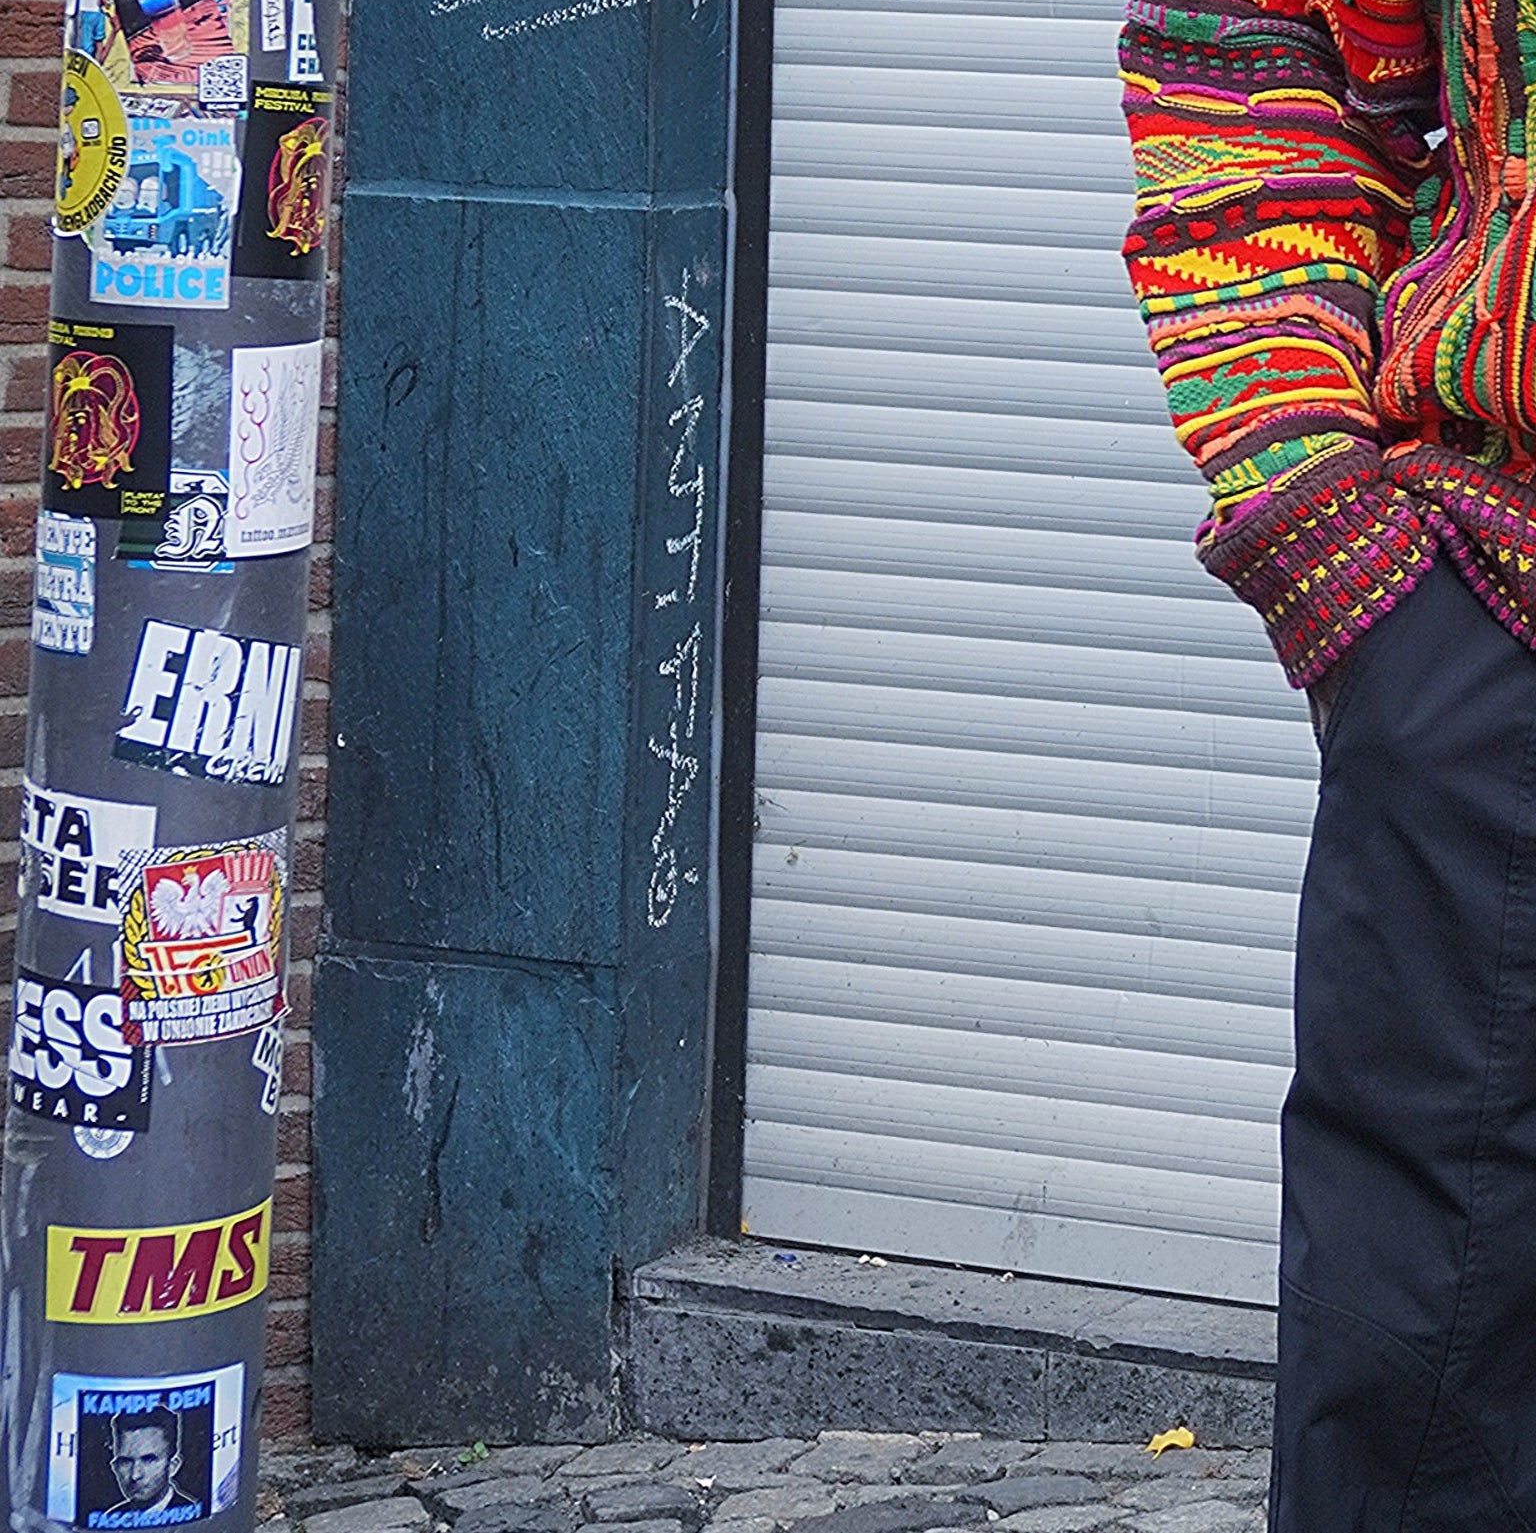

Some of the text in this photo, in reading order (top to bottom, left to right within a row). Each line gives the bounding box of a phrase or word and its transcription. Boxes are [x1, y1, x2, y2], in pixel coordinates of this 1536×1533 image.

[181, 128, 230, 146] Oink
[94, 261, 227, 301] POLICE
[70, 1209, 263, 1314] TMS
[82, 1384, 212, 1415] KAMPF DEM
